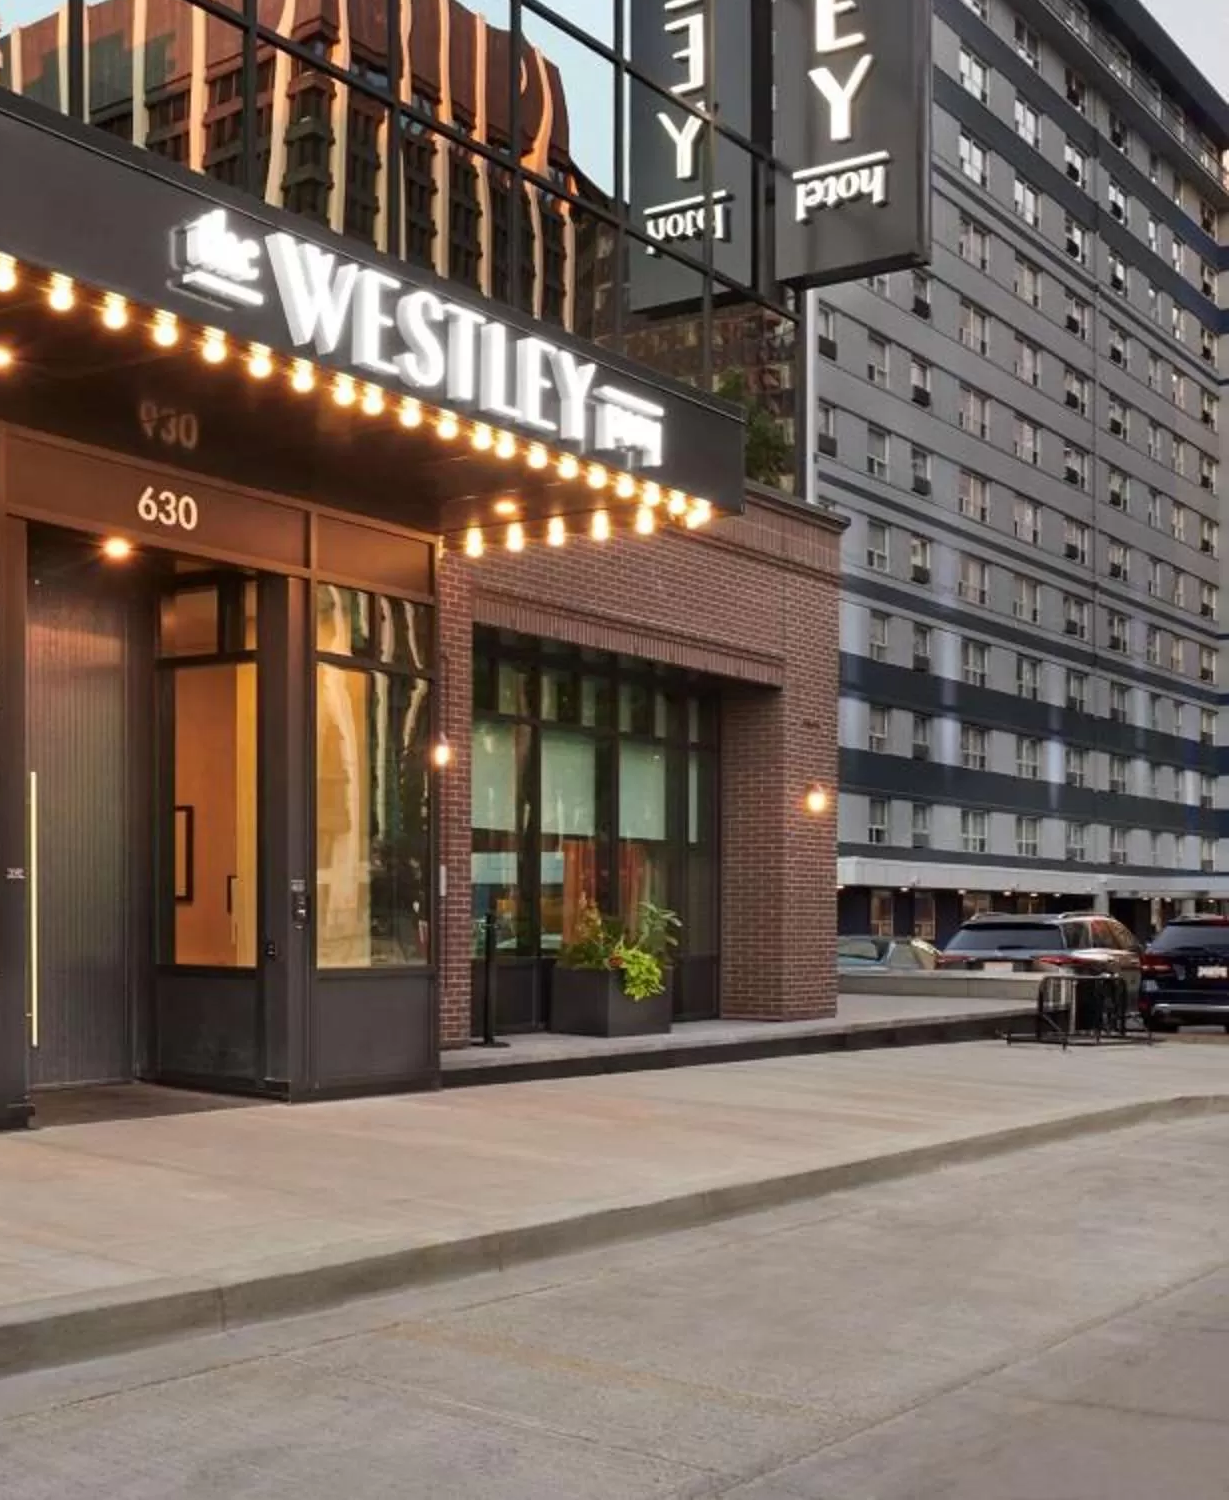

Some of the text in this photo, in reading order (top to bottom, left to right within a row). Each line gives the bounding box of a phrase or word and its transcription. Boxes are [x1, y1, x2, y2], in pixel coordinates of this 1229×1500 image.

[795, 164, 886, 223] hotel
[265, 231, 595, 441] WESTLEY
[137, 485, 199, 531] 630
